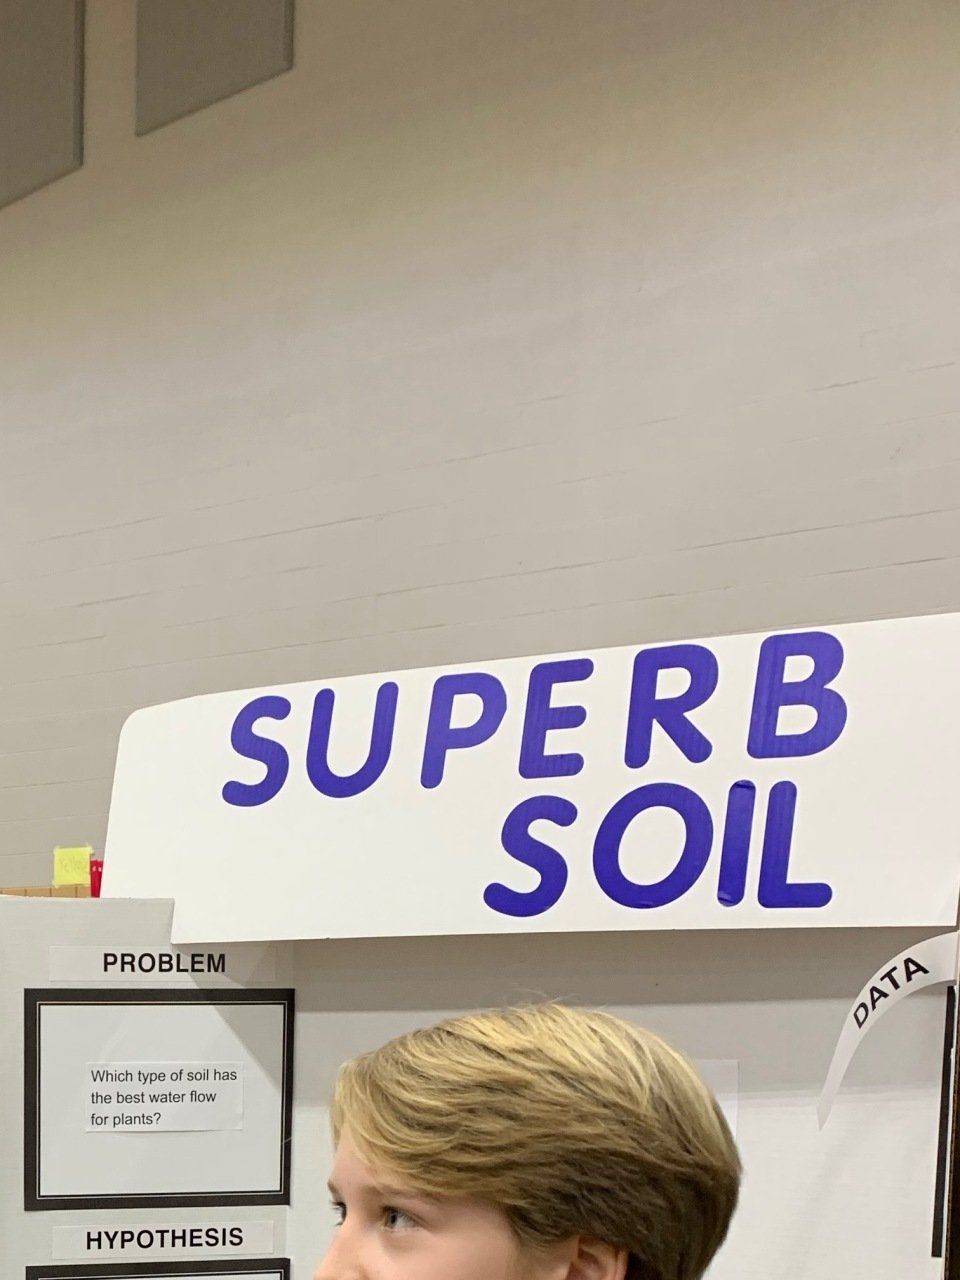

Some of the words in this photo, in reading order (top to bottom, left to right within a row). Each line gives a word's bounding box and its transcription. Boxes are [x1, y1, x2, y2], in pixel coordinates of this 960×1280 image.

[222, 631, 847, 807] SUPERB
[483, 780, 833, 918] SOIL
[103, 952, 226, 973] PROBLEM
[853, 957, 930, 1029] DATA
[91, 1068, 133, 1083] Which
[137, 1069, 166, 1084] type
[170, 1068, 183, 1082] of
[187, 1068, 209, 1082] soil
[213, 1068, 237, 1081] has
[91, 1091, 112, 1105] the
[116, 1091, 145, 1104] best
[149, 1092, 186, 1104] water
[189, 1089, 217, 1103] flow
[91, 1112, 108, 1126] for
[112, 1111, 161, 1127] plants?
[85, 1228, 244, 1251] HYPOTHESIS
